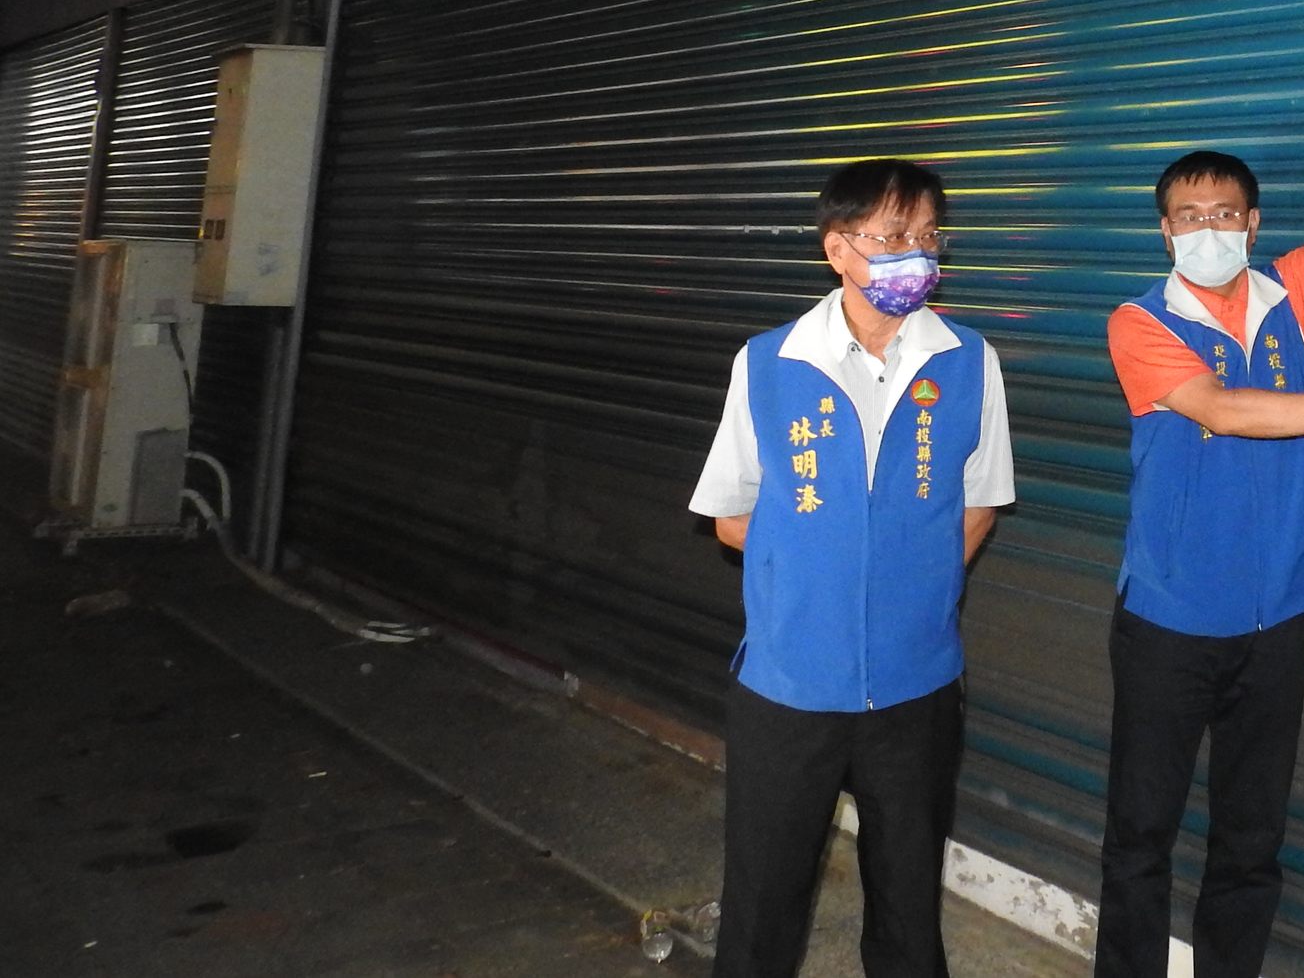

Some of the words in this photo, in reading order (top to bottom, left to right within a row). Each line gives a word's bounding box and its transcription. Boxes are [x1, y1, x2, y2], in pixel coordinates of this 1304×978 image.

[818, 395, 837, 438] 縣長
[915, 409, 933, 500] 南投縣政府
[788, 416, 824, 514] 林明溱
